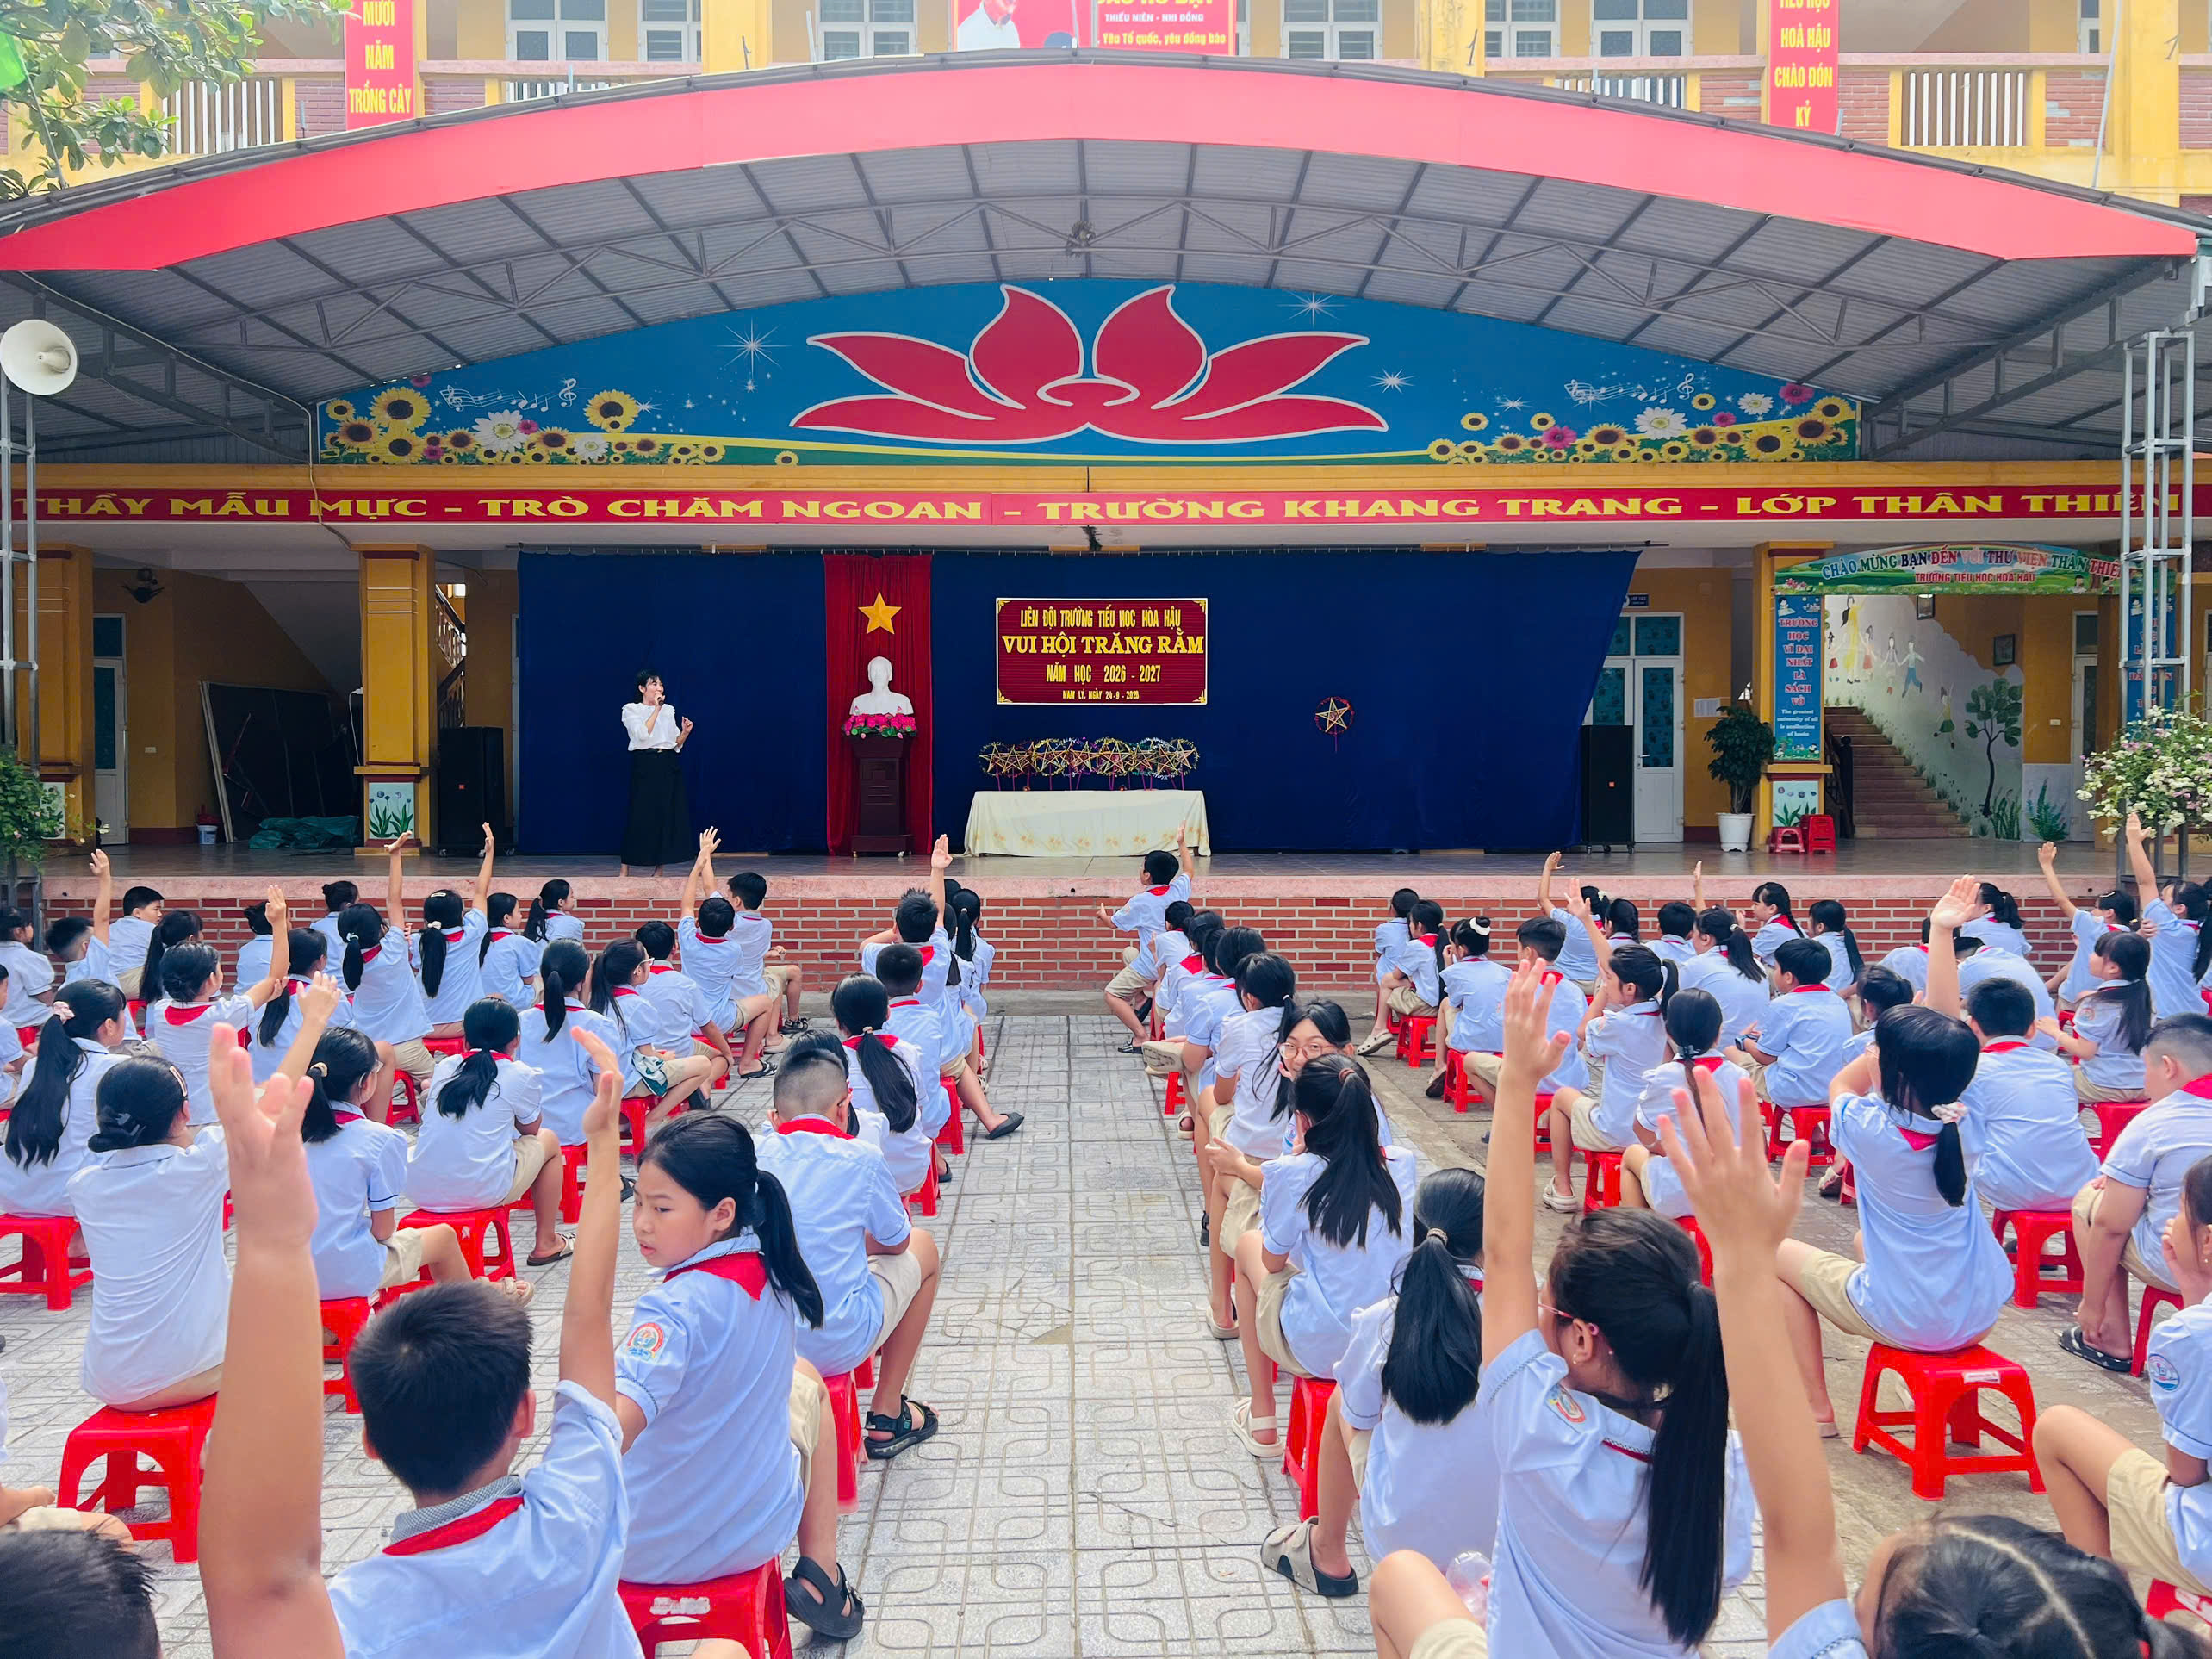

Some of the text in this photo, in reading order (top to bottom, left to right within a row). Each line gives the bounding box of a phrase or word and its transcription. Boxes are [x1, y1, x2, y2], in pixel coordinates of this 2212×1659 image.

[1162, 13, 1177, 22] NHI
[1780, 22, 1831, 53] HOÀ HẬU
[364, 39, 395, 70] NĂM
[1774, 62, 1833, 88] CHÀO ĐÓN
[388, 83, 412, 114] CÂY
[13, 492, 154, 515] THẦY
[168, 491, 290, 516] MẪU
[308, 498, 427, 519] MỰC
[477, 495, 590, 517] TRÒ
[606, 496, 764, 519] CHĂM
[780, 500, 982, 519] NGOAN
[1035, 498, 1265, 519] TRƯỜNG
[1283, 498, 1480, 518] KHANG
[1497, 497, 1683, 517] TRANG
[1736, 493, 1837, 515] LỚP
[1852, 492, 2003, 513] THÂN
[1822, 558, 1858, 579] CHÀO
[1858, 554, 1898, 572] MỪNG
[1900, 551, 1928, 570] BẠN
[1930, 545, 1958, 565] ĐẾN
[1987, 549, 2016, 565] THƯ
[2051, 552, 2088, 572] THÂN
[1020, 604, 1182, 630] LIÊN ĐỘI TRƯỜNG TIỂU HỌC HÒA HẬU
[1002, 627, 1204, 658] VUI HỘI TRĂNG RẰM
[1787, 631, 1810, 642] HỌC
[1046, 662, 1066, 682] NĂM
[1074, 664, 1092, 685] HỌC
[1103, 664, 1127, 683] 2026
[1139, 664, 1161, 683] 2027
[1793, 668, 1806, 680] LÀ
[1062, 690, 1076, 699] NAM
[1088, 687, 1103, 699] NGÀY
[1785, 681, 1811, 693] SÁCH
